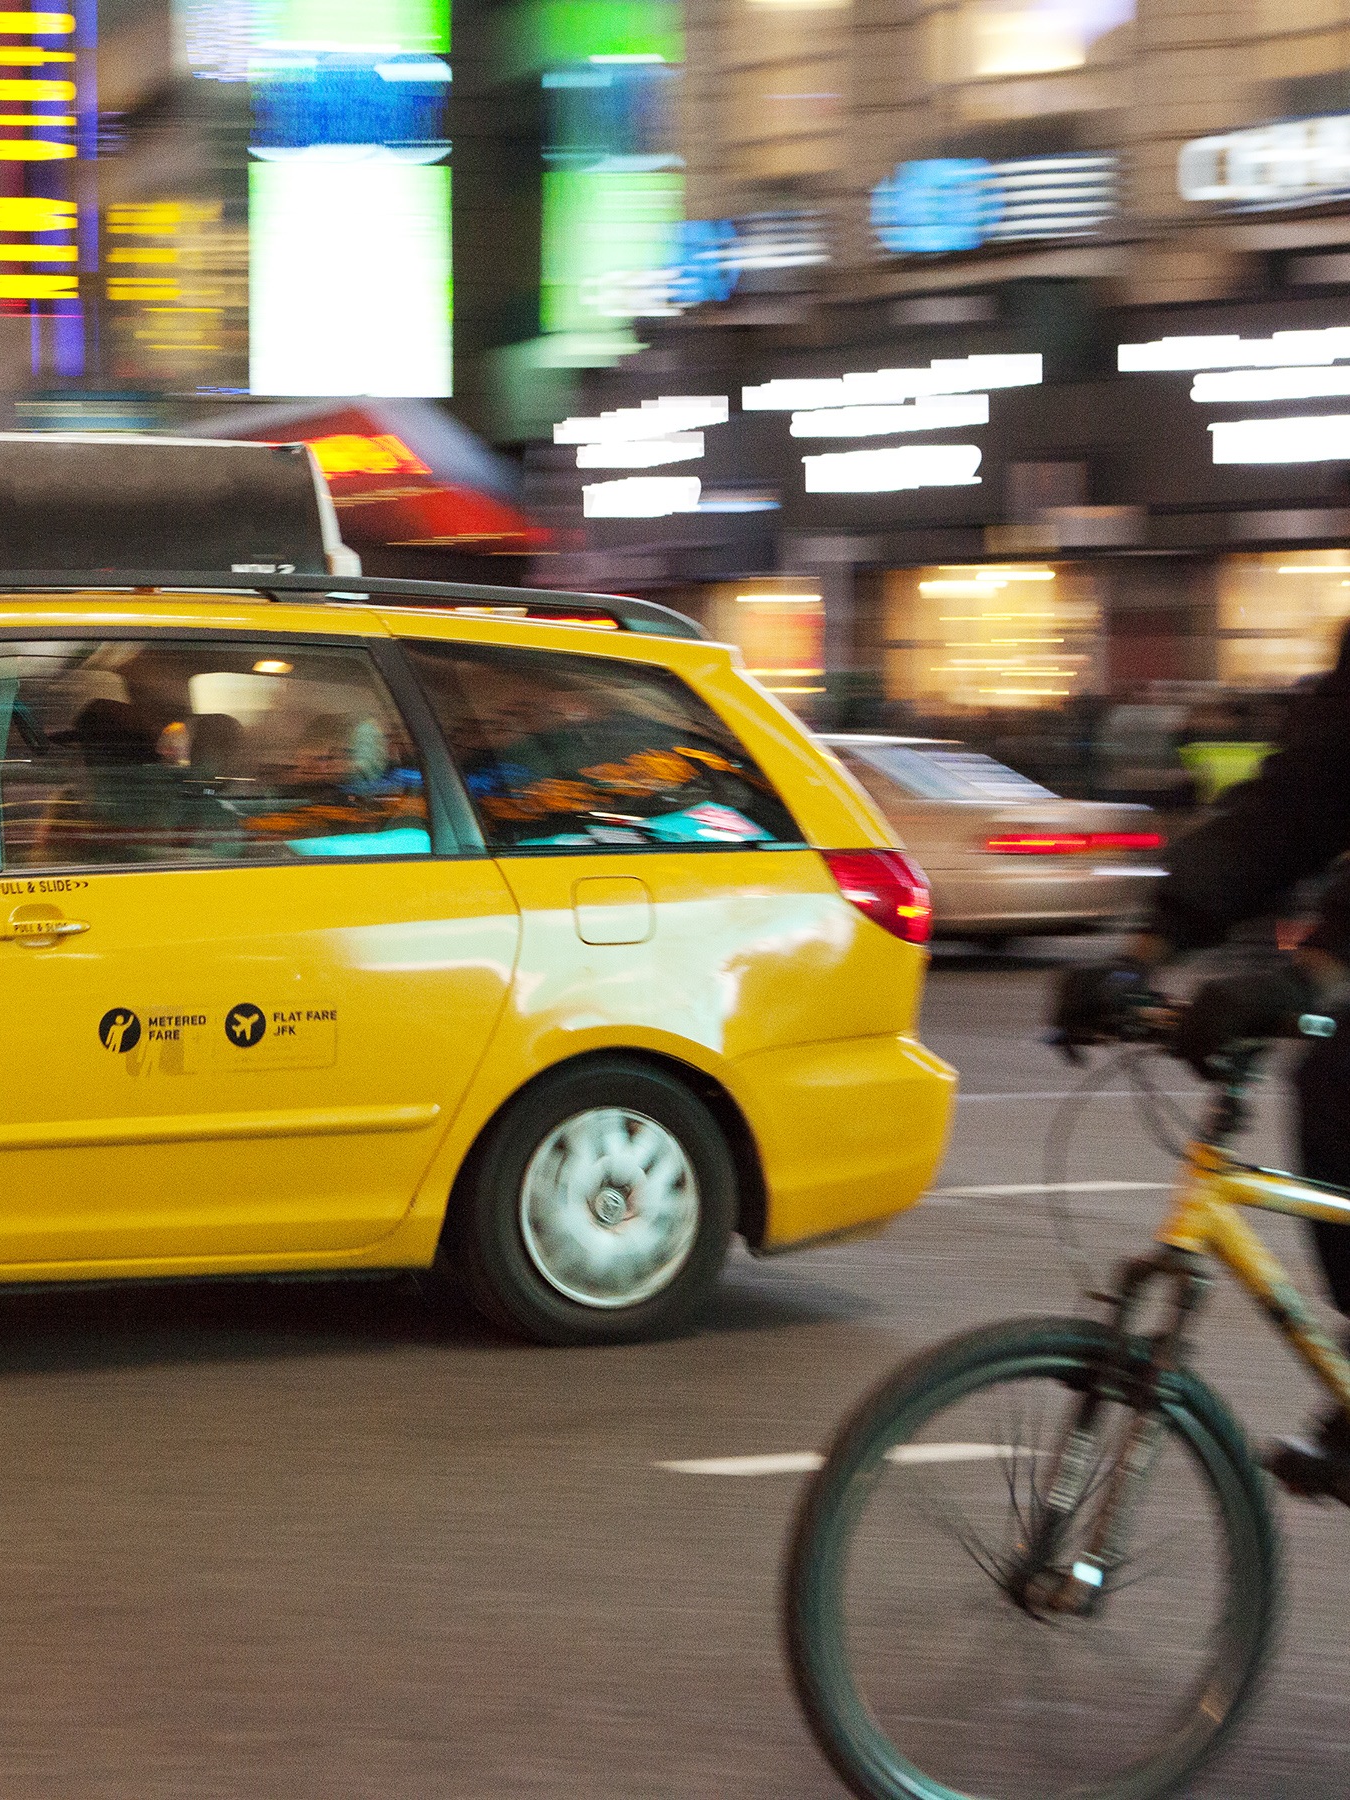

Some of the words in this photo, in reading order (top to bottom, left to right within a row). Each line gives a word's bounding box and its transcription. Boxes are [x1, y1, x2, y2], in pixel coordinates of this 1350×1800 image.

[27, 881, 35, 893] &
[39, 879, 72, 893] SLIDE
[148, 1014, 207, 1028] METERED
[272, 1011, 303, 1023] FLAT
[306, 1010, 338, 1021] FARE
[148, 1029, 181, 1042] FARE
[273, 1024, 297, 1037] JFK
